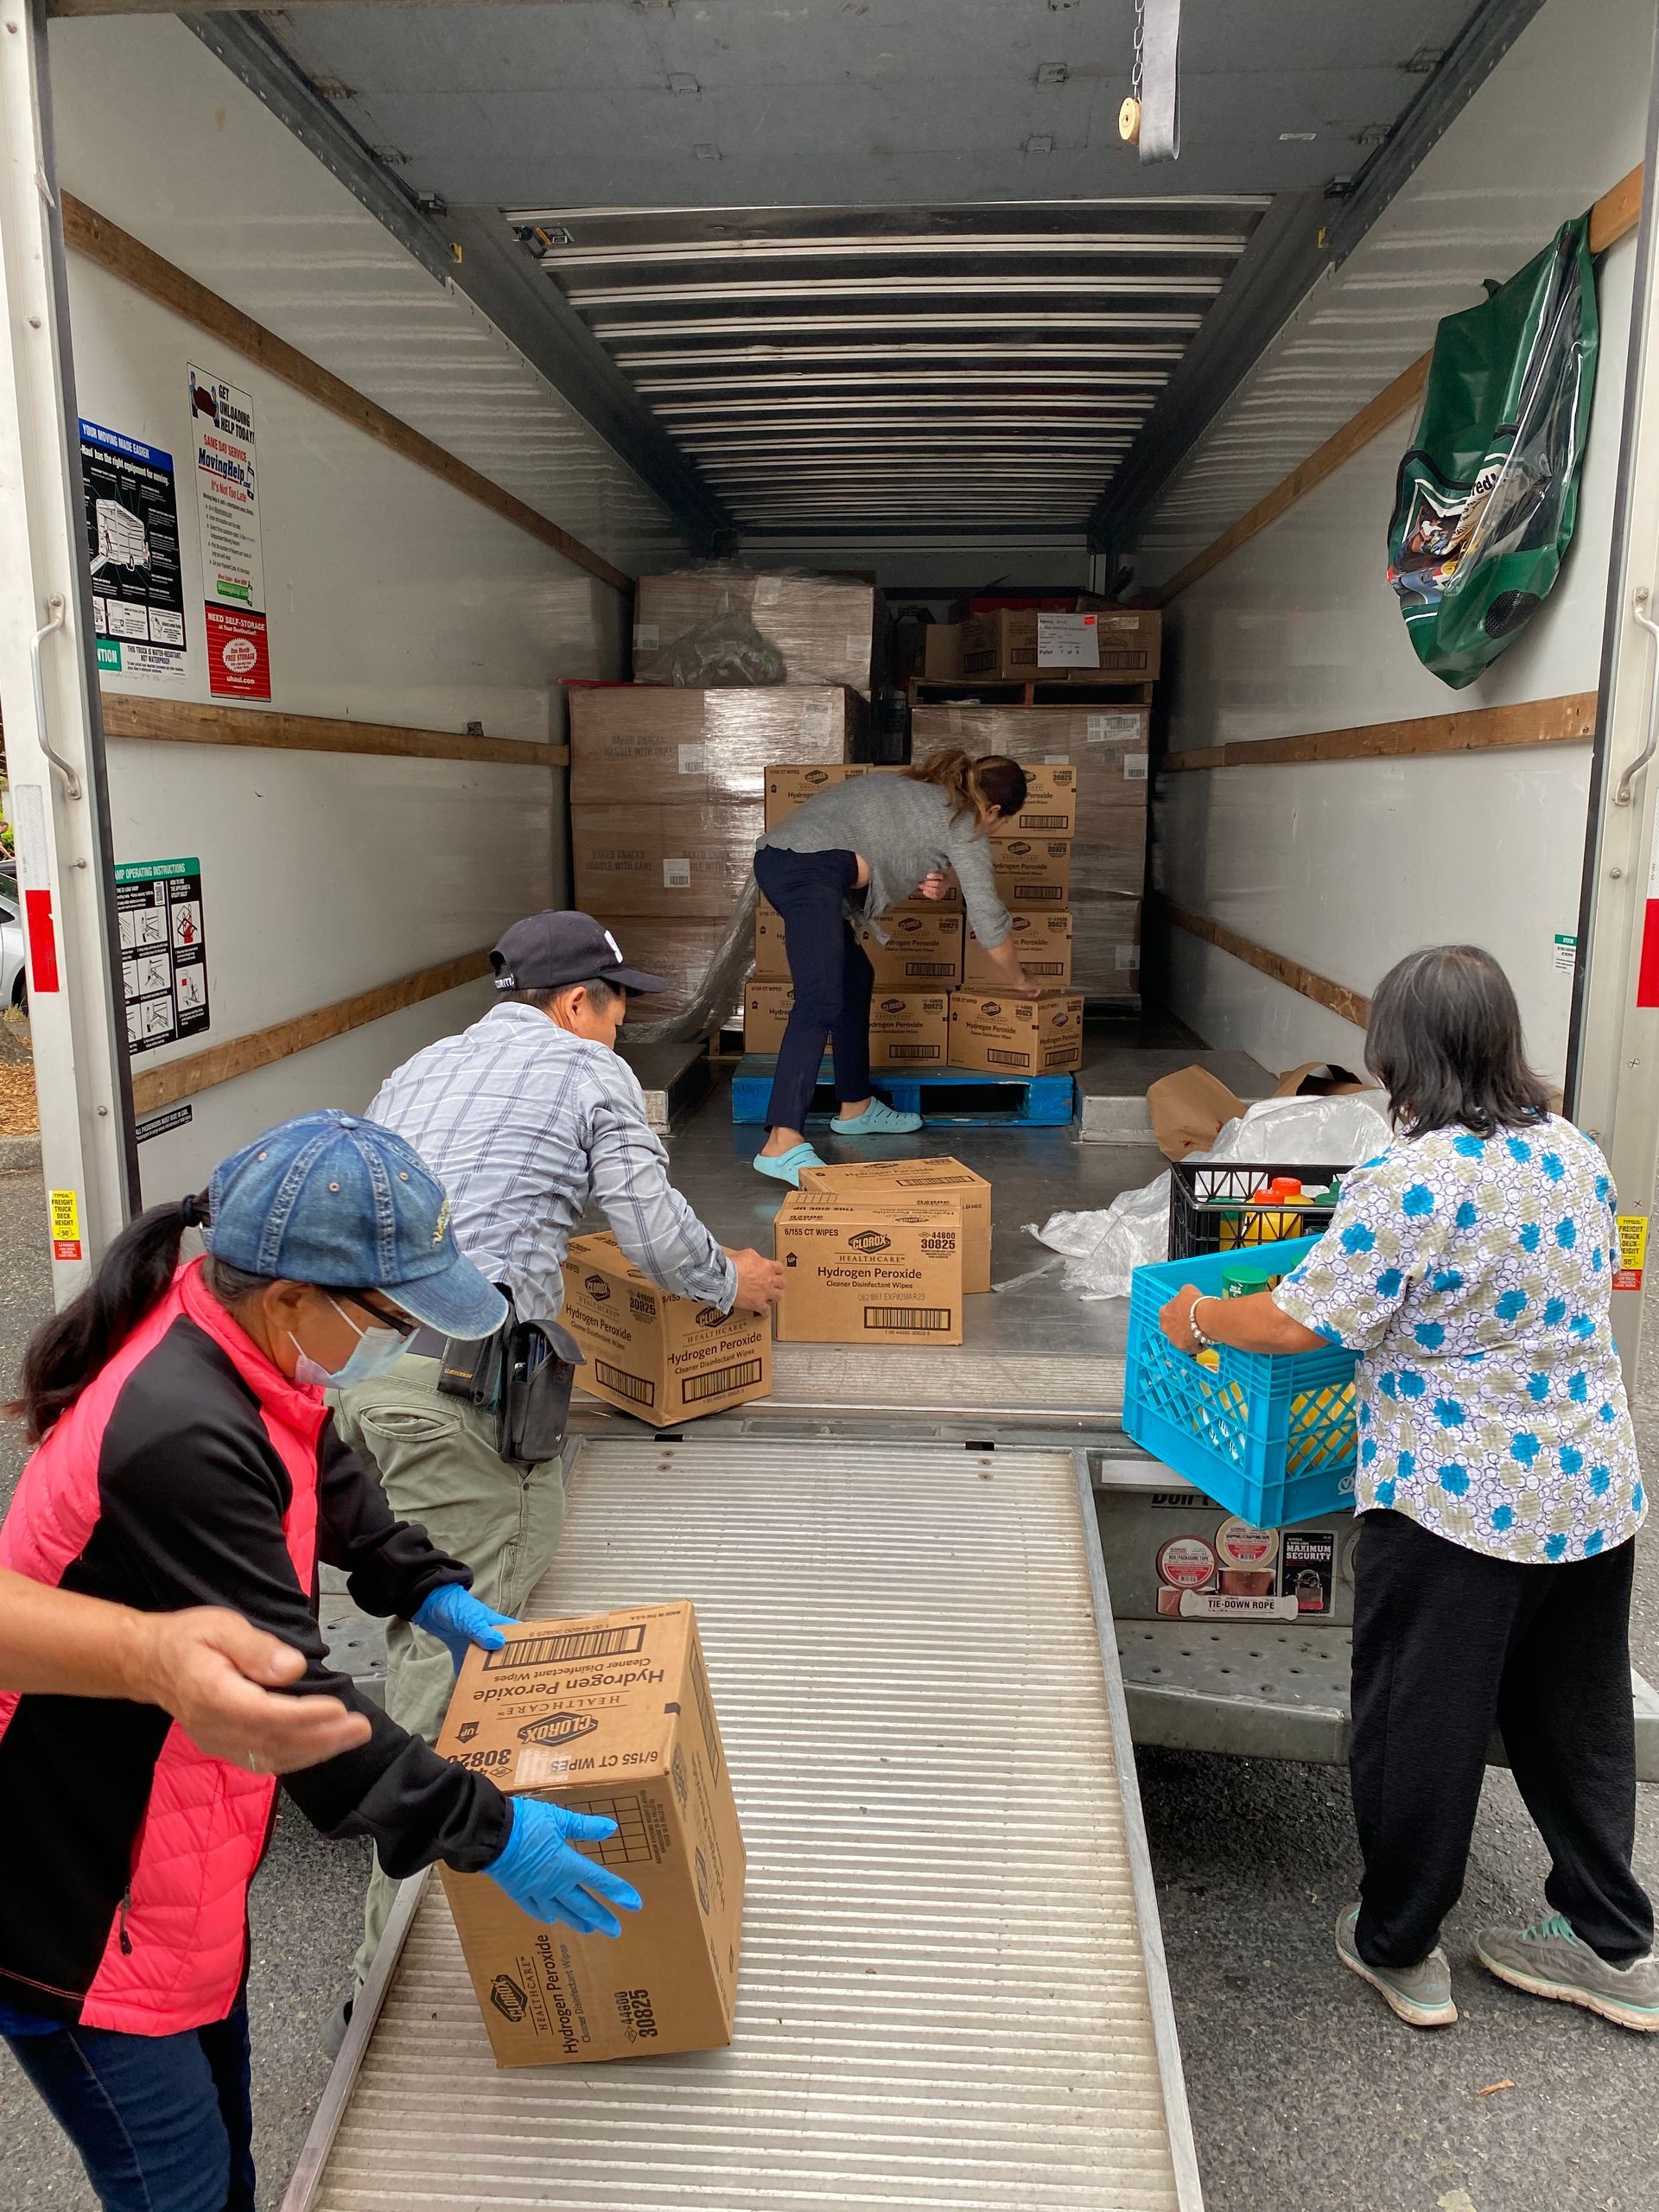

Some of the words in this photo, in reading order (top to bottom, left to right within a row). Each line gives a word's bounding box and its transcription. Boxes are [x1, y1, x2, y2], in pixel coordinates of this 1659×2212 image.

[219, 385, 229, 401] GET
[219, 401, 251, 427] UNLOADING
[220, 416, 234, 435] HELP
[235, 424, 255, 445] TODAY!
[82, 423, 98, 439] YOUR
[97, 429, 118, 448] MOVING
[118, 437, 133, 453] MADE
[132, 443, 149, 459] EASIER
[204, 434, 218, 450] SAME
[219, 440, 227, 454] DAY
[227, 445, 247, 463] SERVICE
[94, 449, 104, 461] has
[104, 453, 112, 464] the
[112, 456, 124, 469] right
[211, 480, 219, 493] It's
[219, 483, 228, 496] Not
[228, 486, 237, 499] Too
[237, 490, 247, 503] Late
[207, 612, 224, 622] NEED
[225, 616, 265, 632] SELF-STORAGE
[136, 646, 148, 655] TRUCK
[237, 652, 255, 661] STORAGE
[226, 676, 255, 684] uhaul.com
[125, 867, 153, 880] OPERATING
[152, 863, 186, 876] INSTRUCTIONS
[966, 1021, 992, 1032] Hydrogen
[992, 1025, 1016, 1034] Peroxide
[141, 1120, 162, 1134] PASSENGERS
[161, 1116, 170, 1125] MUST
[169, 1112, 178, 1121] RIDE
[851, 1235, 888, 1250] CLOROX
[920, 1239, 956, 1250] 30825
[817, 1267, 871, 1280] Hydrogen
[874, 1268, 923, 1280] Peroxide
[629, 1297, 656, 1315] 30825
[566, 1303, 599, 1328] Hydrogen
[600, 1316, 632, 1342] Peroxide
[667, 1345, 717, 1366] Hydrogen
[720, 1332, 762, 1351] Peroxide
[675, 1363, 699, 1375] Cleaner
[700, 1353, 735, 1368] Disinfectant
[736, 1348, 755, 1359] Wipes
[1286, 1552, 1332, 1560] SECURITY
[1208, 1599, 1250, 1609] TIE-DOWN
[1252, 1601, 1274, 1610] ROPE
[534, 1662, 603, 1678] Disinfectant
[607, 1657, 652, 1671] Cleaner
[493, 1671, 531, 1683] Wipes
[566, 1668, 664, 1690] Hydrogen
[473, 1681, 560, 1703] Peroxide
[461, 1727, 475, 1737] UP
[520, 1713, 593, 1745] CLOROX
[550, 1757, 595, 1772] WIPES
[598, 1754, 619, 1768] CT
[622, 1751, 658, 1765] 6/155
[534, 1934, 562, 1991] Peroxide
[560, 1943, 572, 1970] Wipes
[491, 1978, 526, 2018] CLOROX
[567, 1970, 584, 2015] Disinfectant
[613, 1991, 634, 2025] 44600
[627, 1989, 658, 2038] 30825
[553, 1993, 579, 2054] Hydrogen
[578, 2015, 591, 2044] Cleaner
